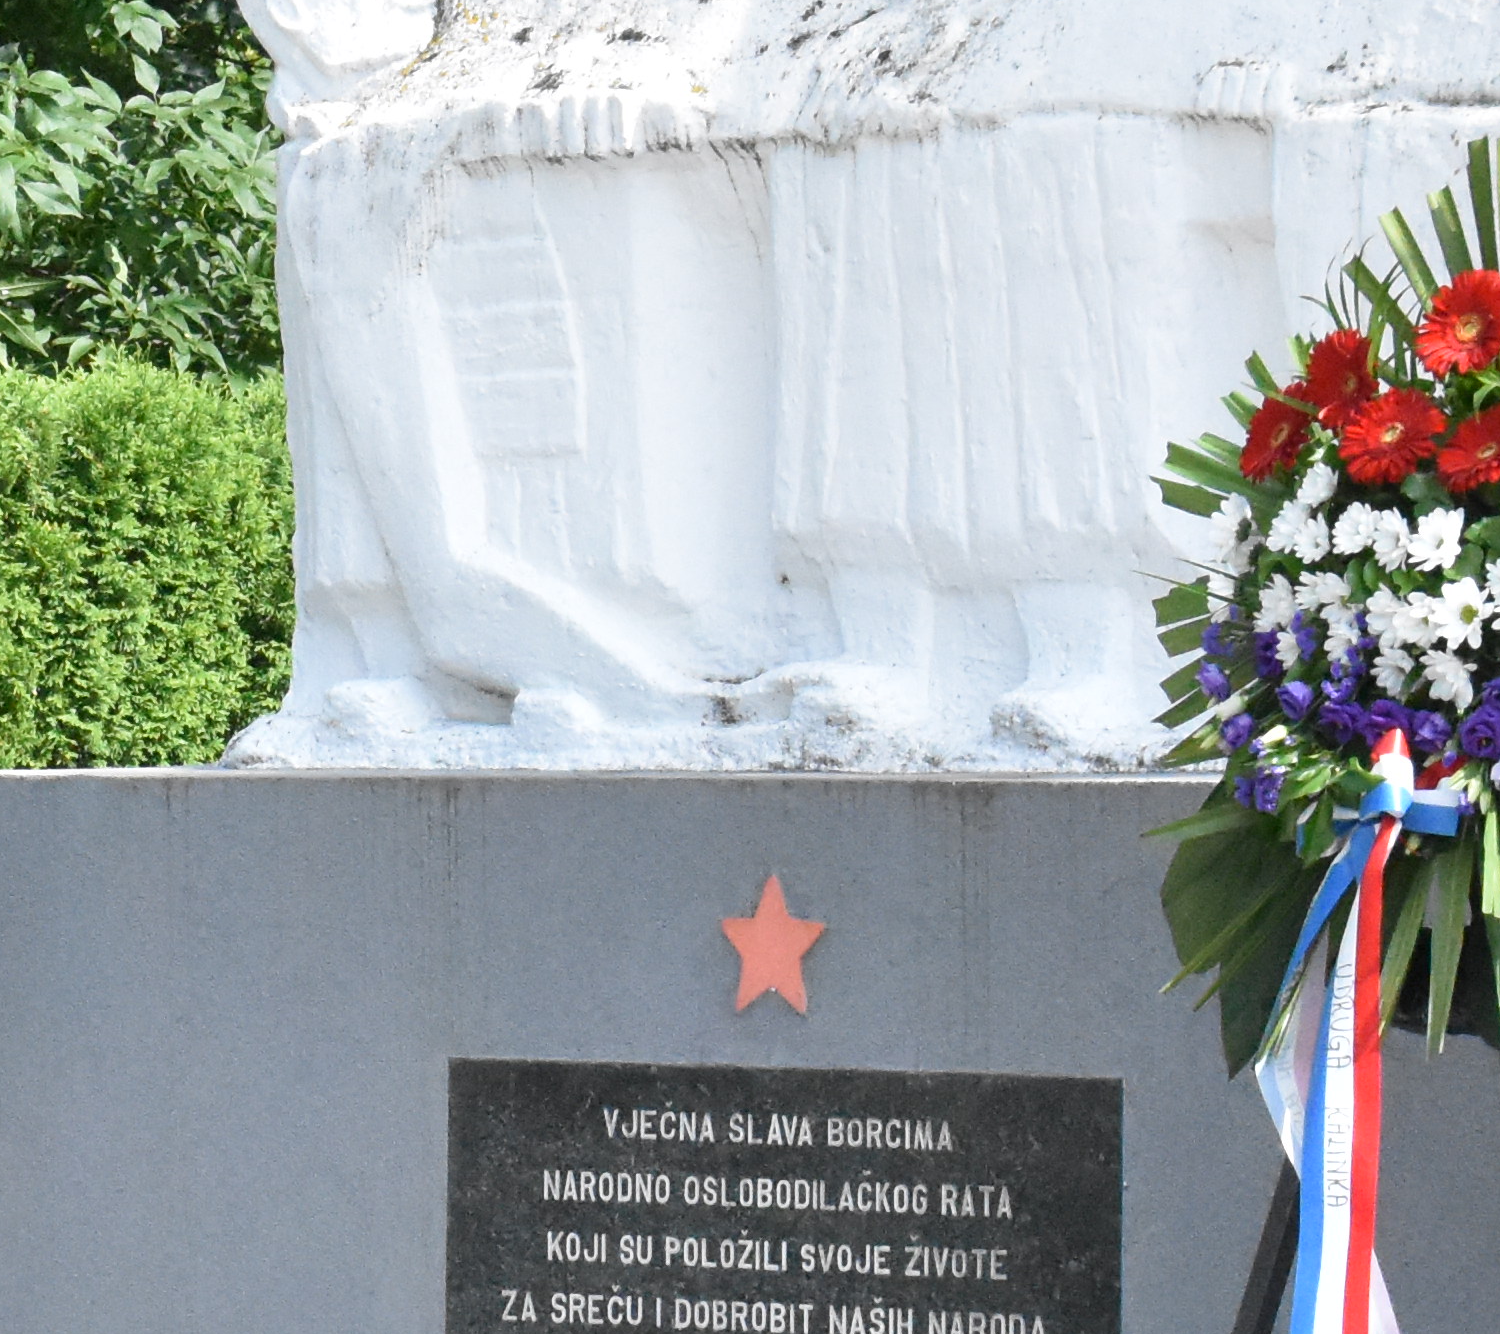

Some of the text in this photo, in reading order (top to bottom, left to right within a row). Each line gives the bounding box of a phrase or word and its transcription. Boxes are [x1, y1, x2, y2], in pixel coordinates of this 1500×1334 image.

[603, 1101, 953, 1151] VJEČNA SLAVA BORCIMA
[542, 1168, 1013, 1219] NARODNO OSLOBODILAČKOG RATA
[546, 1229, 1008, 1281] KOJI SU POLOŽILI SVOJE ŽIVOTE
[500, 1288, 538, 1323] ZA
[550, 1283, 644, 1327] SREČU
[655, 1296, 663, 1328] I
